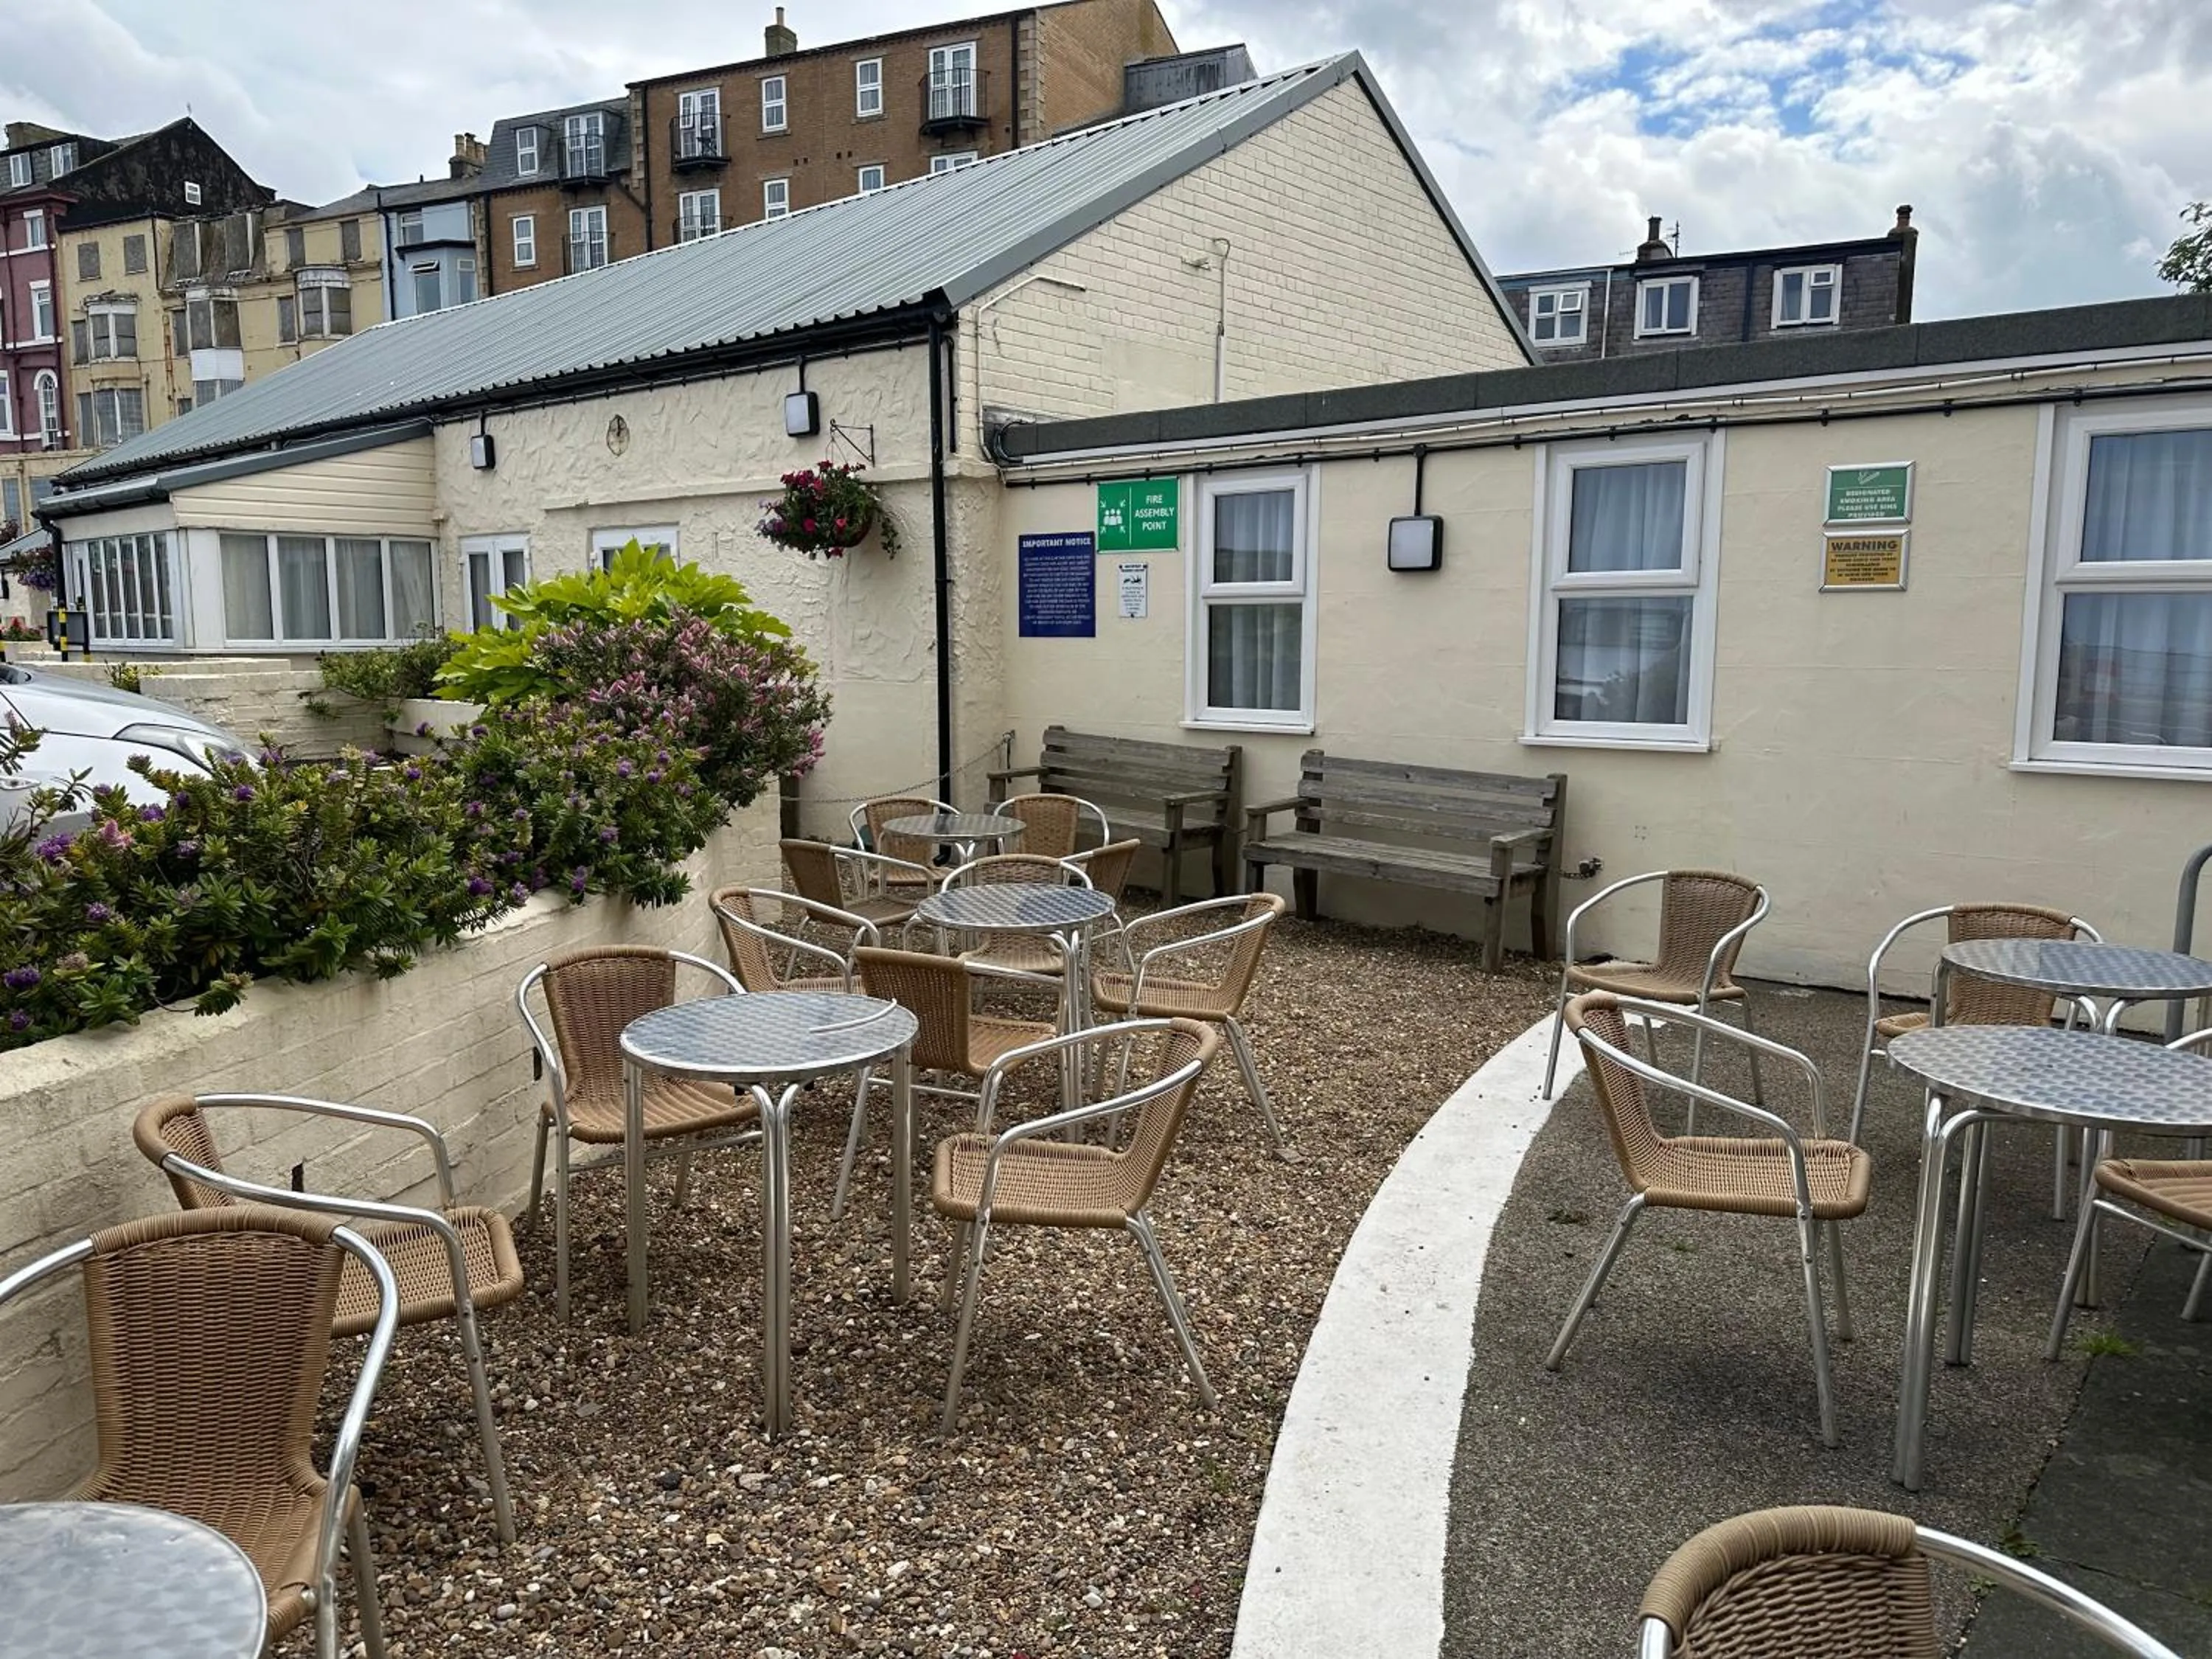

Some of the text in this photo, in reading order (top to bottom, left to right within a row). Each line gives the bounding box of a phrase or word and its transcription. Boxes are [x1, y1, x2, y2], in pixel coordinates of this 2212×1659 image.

[1145, 495, 1163, 504] FIRE
[1134, 507, 1175, 518] ASSEMBLY
[1142, 521, 1166, 531] POINT
[1023, 537, 1091, 548] IMPORTANT NOTICE
[1831, 540, 1898, 551] WARNING
